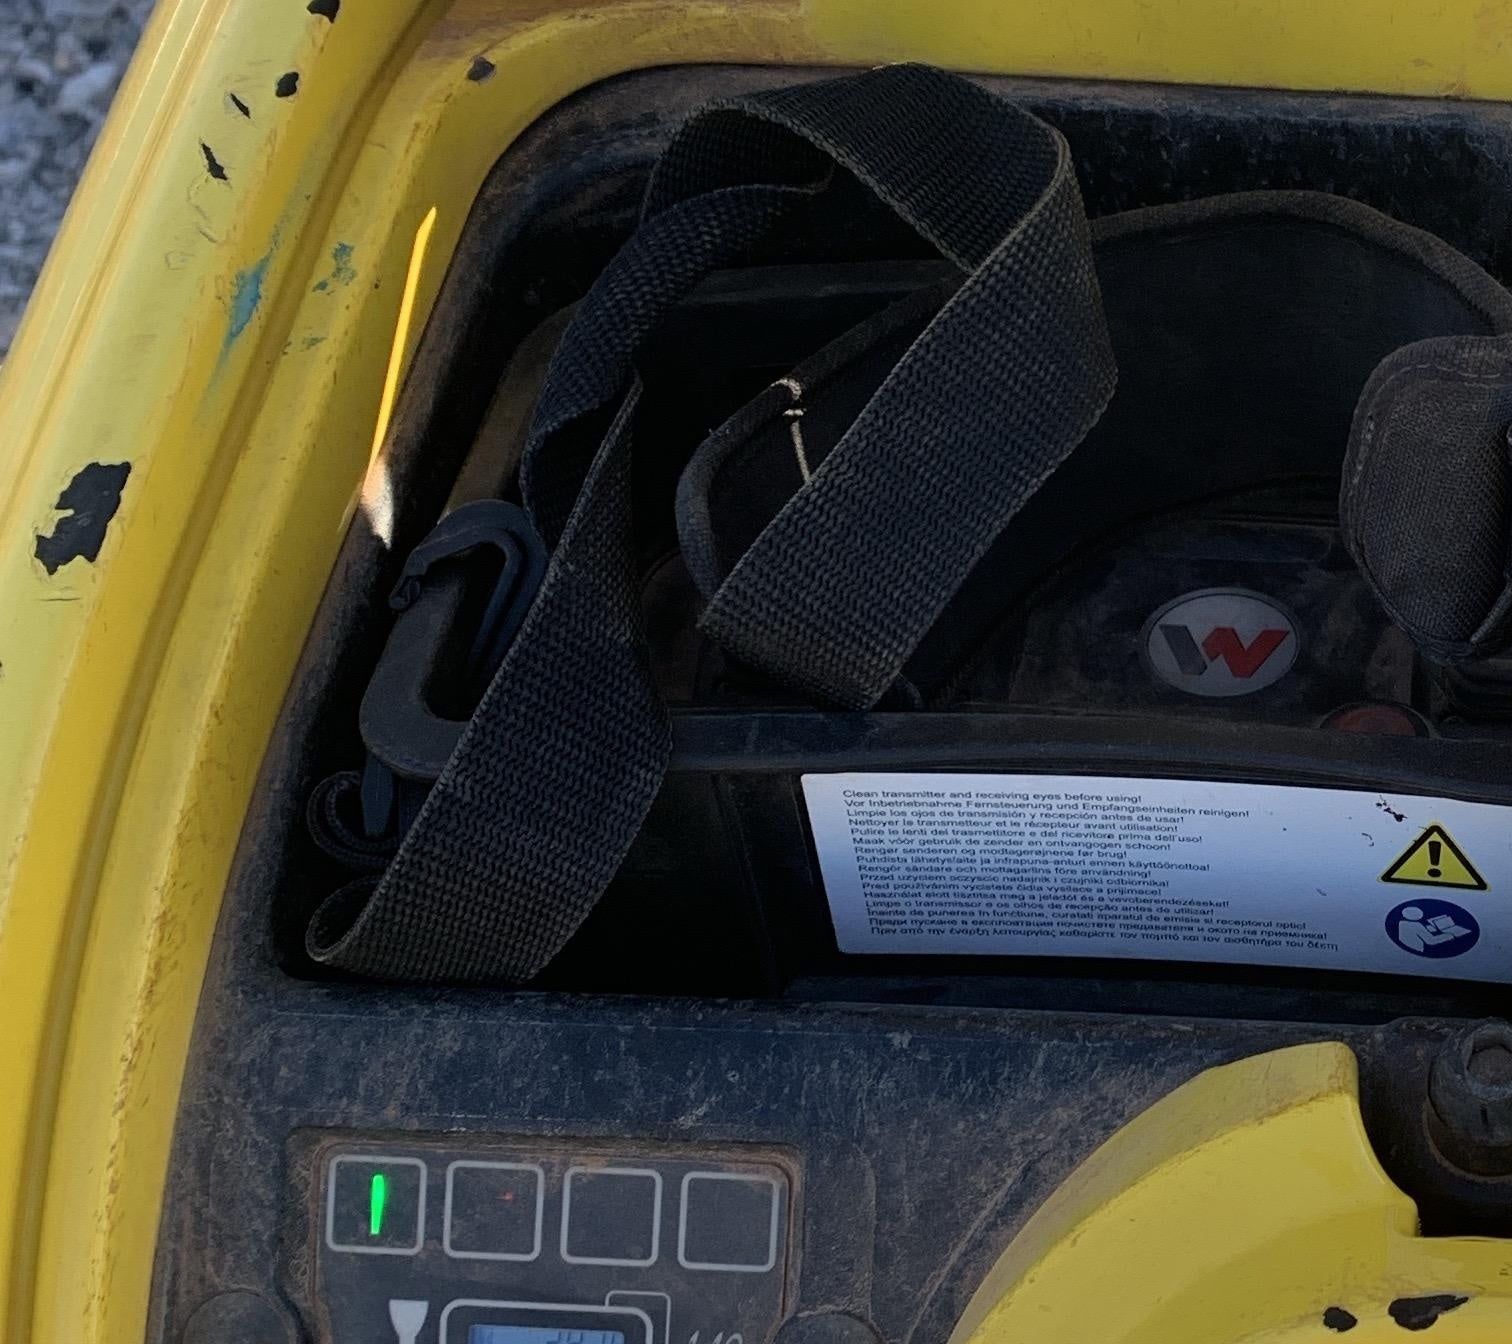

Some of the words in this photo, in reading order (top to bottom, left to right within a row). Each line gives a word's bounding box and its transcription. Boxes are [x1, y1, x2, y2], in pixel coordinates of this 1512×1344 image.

[842, 790, 878, 798] Clean
[881, 790, 945, 799] transmitter
[949, 791, 972, 799] and
[976, 791, 1029, 802] receiving
[1033, 793, 1061, 802] eyes
[1064, 793, 1103, 802] before
